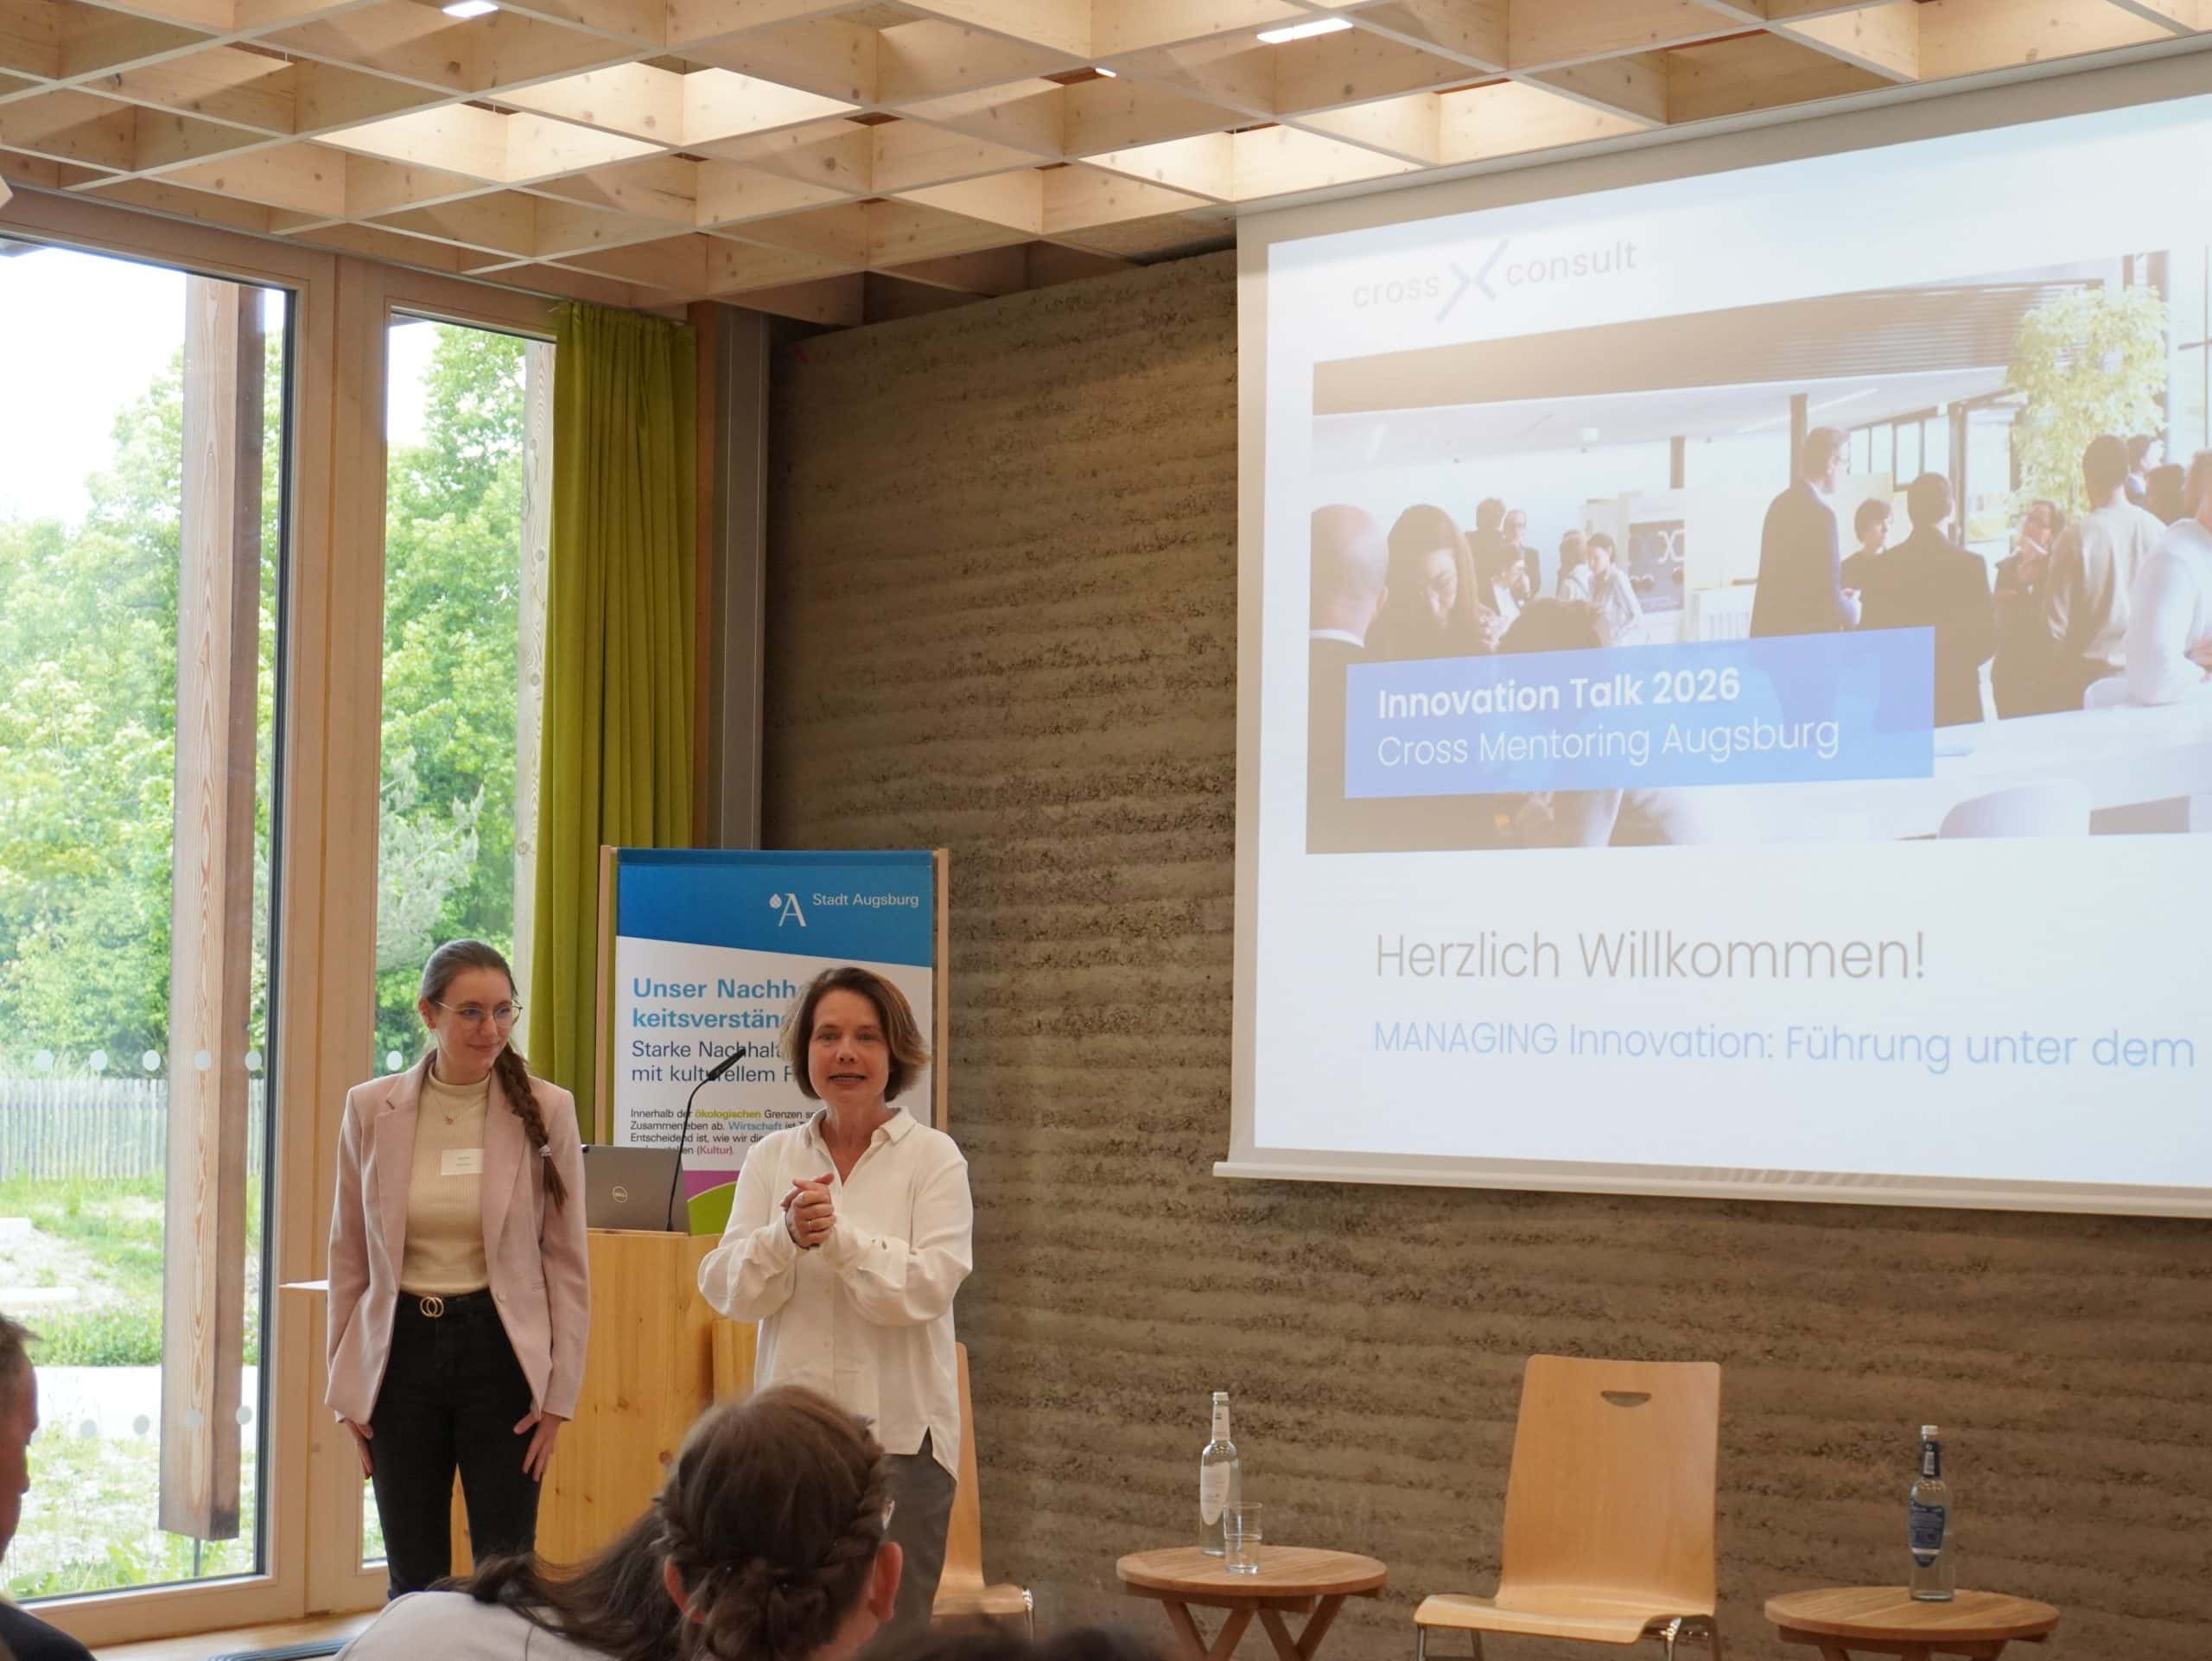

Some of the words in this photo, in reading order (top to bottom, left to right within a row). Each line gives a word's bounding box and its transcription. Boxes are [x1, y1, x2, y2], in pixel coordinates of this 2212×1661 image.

[1353, 273, 1440, 309] cross
[1506, 240, 1638, 288] consult
[1378, 678, 1559, 720] Innovation
[1569, 672, 1643, 710] Talk
[1652, 666, 1741, 704] 2026
[1377, 733, 1468, 767] Cross
[1478, 723, 1650, 767] Mentoring
[1662, 716, 1840, 762] Augsburg
[812, 893, 849, 907] Stadt
[853, 893, 919, 908] Augsburg
[1376, 930, 1560, 978] Herzlich
[1578, 929, 1924, 979] Willkommen!
[633, 977, 707, 998] Unser
[717, 978, 803, 999] Nachh
[632, 1040, 691, 1058] Starke
[699, 1040, 782, 1059] Nachhalt
[1374, 1021, 1558, 1055] MANAGING
[1569, 1022, 1774, 1059] Innovation:
[1787, 1024, 1951, 1075] Führung
[1967, 1030, 2078, 1066] unter
[2092, 1028, 2195, 1068] dem
[632, 1065, 663, 1081] mit
[670, 1065, 776, 1083] kultellem
[631, 1109, 674, 1118] Innerhalb
[695, 1108, 761, 1121] ökologischen
[764, 1109, 802, 1119] Grenzen
[630, 1121, 708, 1130] Zusammeneben
[728, 1122, 782, 1131] Wirtschaft
[712, 1133, 729, 1142] wie
[732, 1133, 747, 1142] wir
